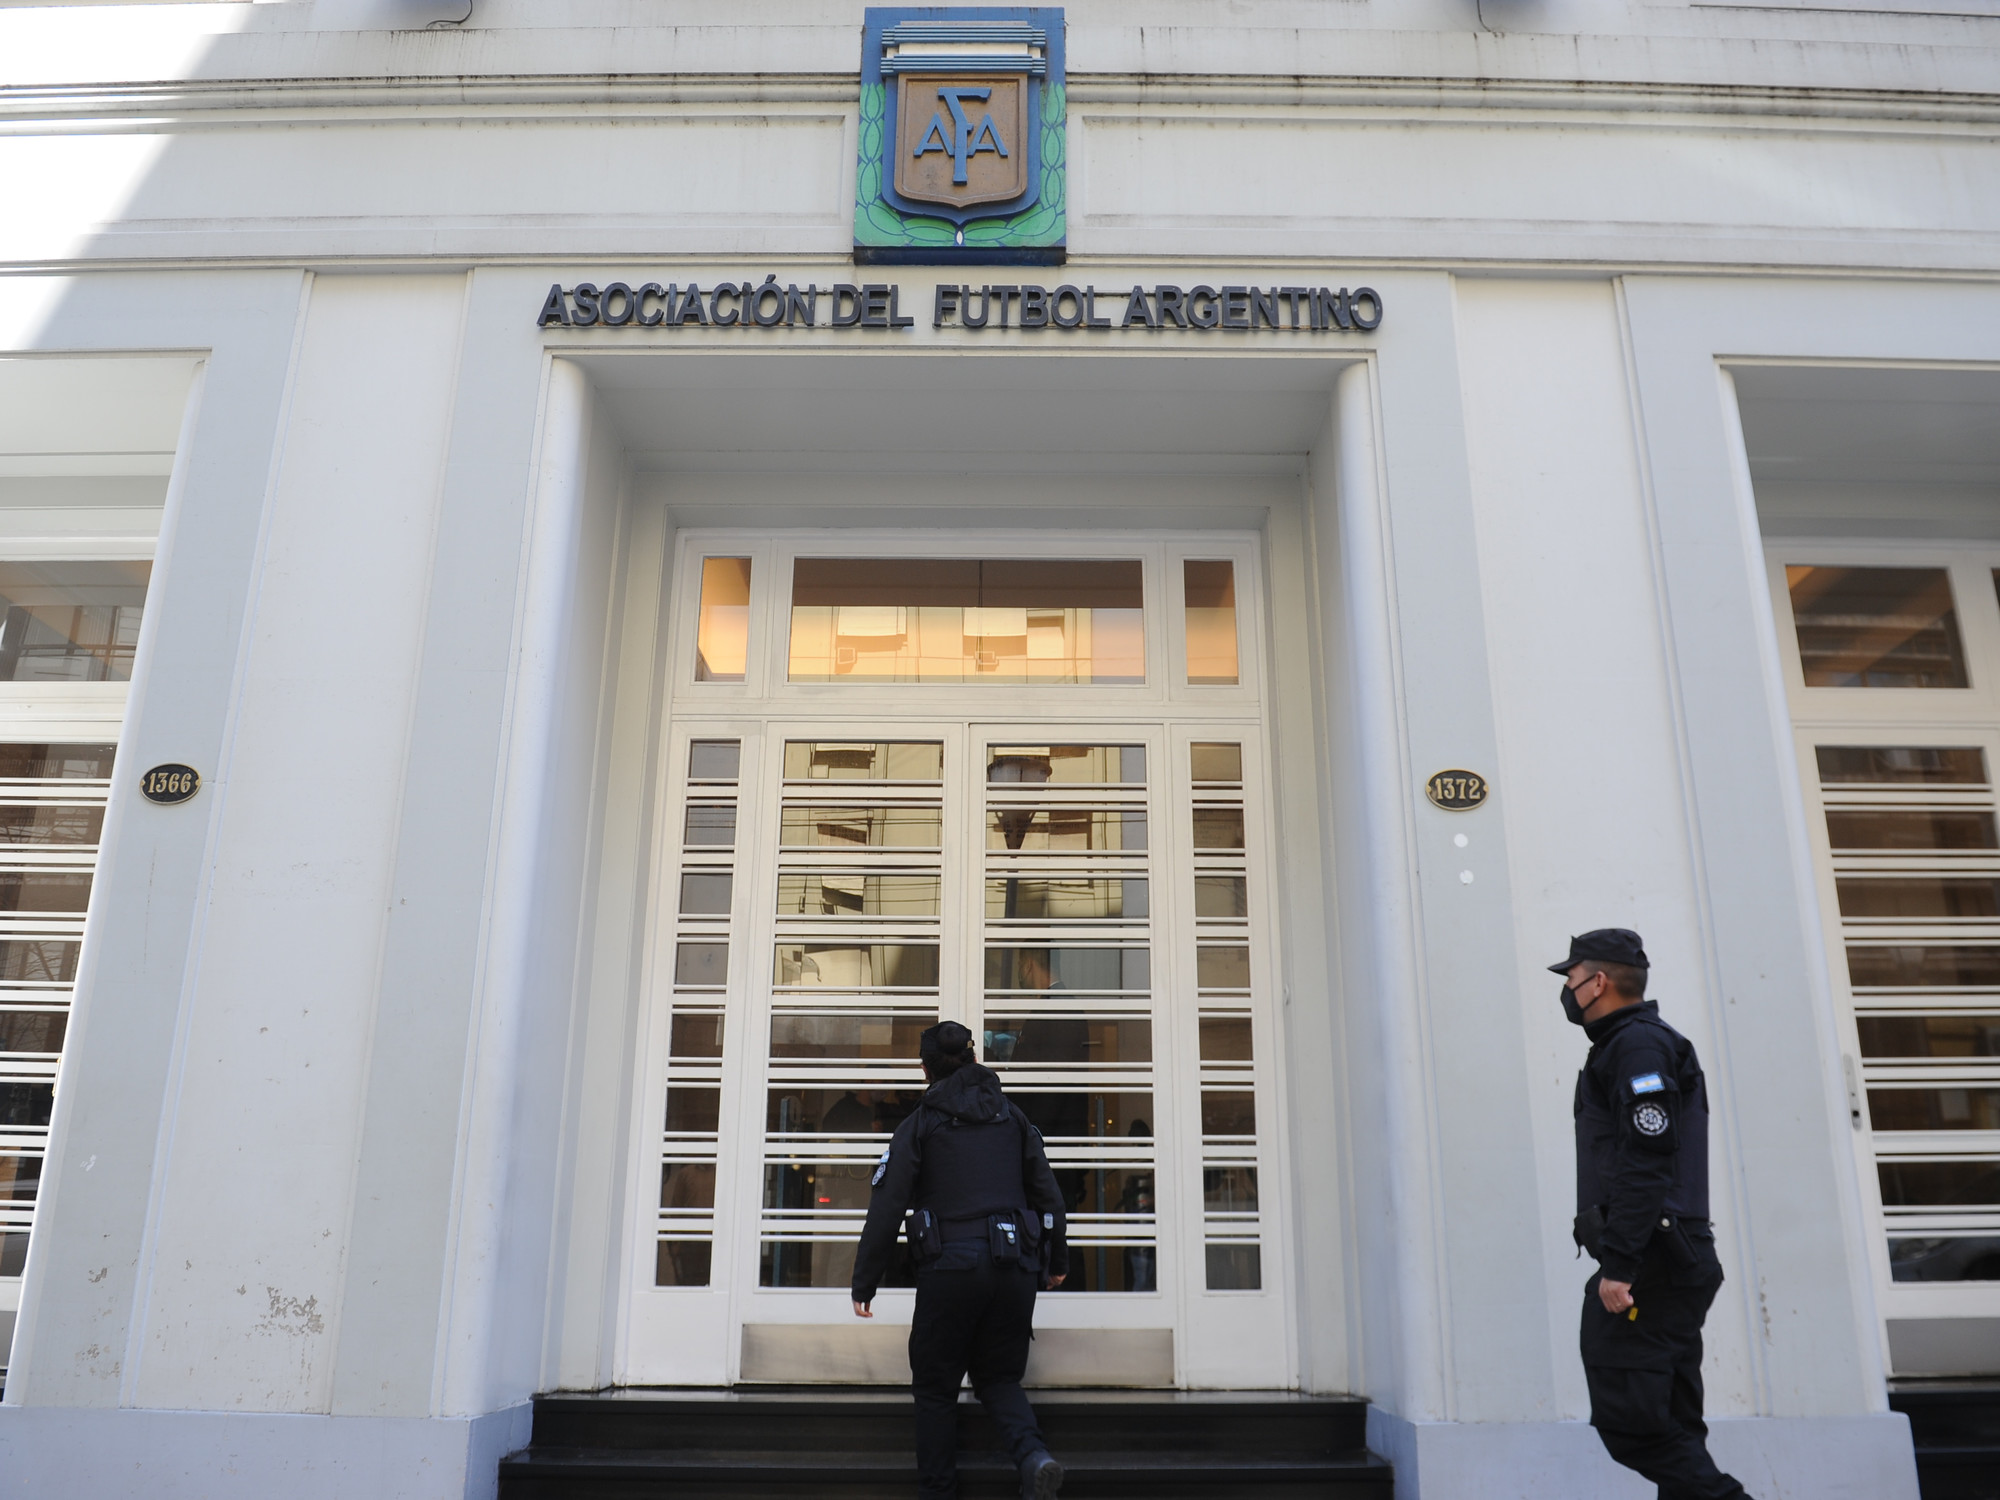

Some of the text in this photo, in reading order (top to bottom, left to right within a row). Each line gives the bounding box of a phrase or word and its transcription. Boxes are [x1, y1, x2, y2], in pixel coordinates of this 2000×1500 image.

[537, 273, 1384, 332] ASOCIACIÓN DEL FUTBOL ARGENTINO
[147, 772, 192, 794] 1366
[1434, 778, 1481, 800] 1372
